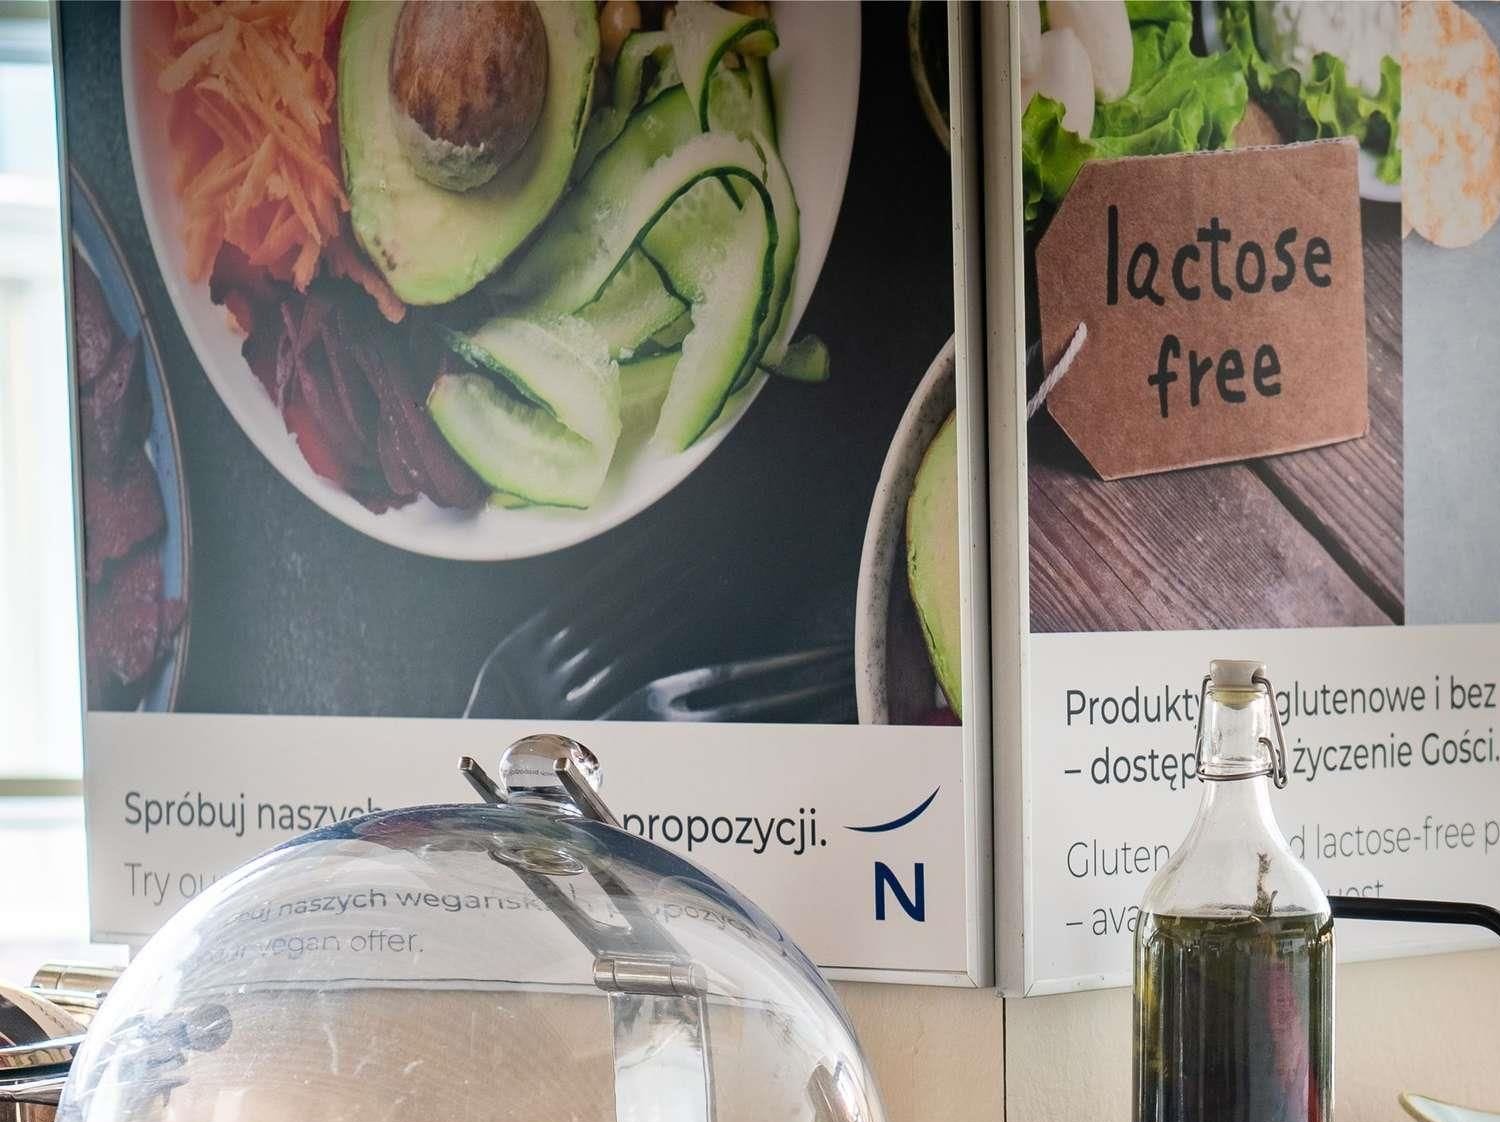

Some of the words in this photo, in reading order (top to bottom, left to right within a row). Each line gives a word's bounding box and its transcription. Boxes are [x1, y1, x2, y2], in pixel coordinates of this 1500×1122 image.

[1106, 204, 1332, 306] lactose
[1147, 333, 1282, 418] free
[1275, 680, 1426, 727] glutenowe
[1434, 675, 1441, 711] i
[1449, 674, 1498, 711] bez
[1090, 746, 1197, 791] dostęp
[1291, 732, 1413, 782] życzenie
[1421, 727, 1500, 767] Gości.
[123, 790, 246, 838] Spróbuj
[622, 806, 828, 857] propozycji.
[1316, 814, 1476, 860] lactose-free
[123, 862, 171, 907] Try
[277, 888, 388, 917] naszych
[874, 860, 926, 923] N
[349, 928, 425, 953] offer.
